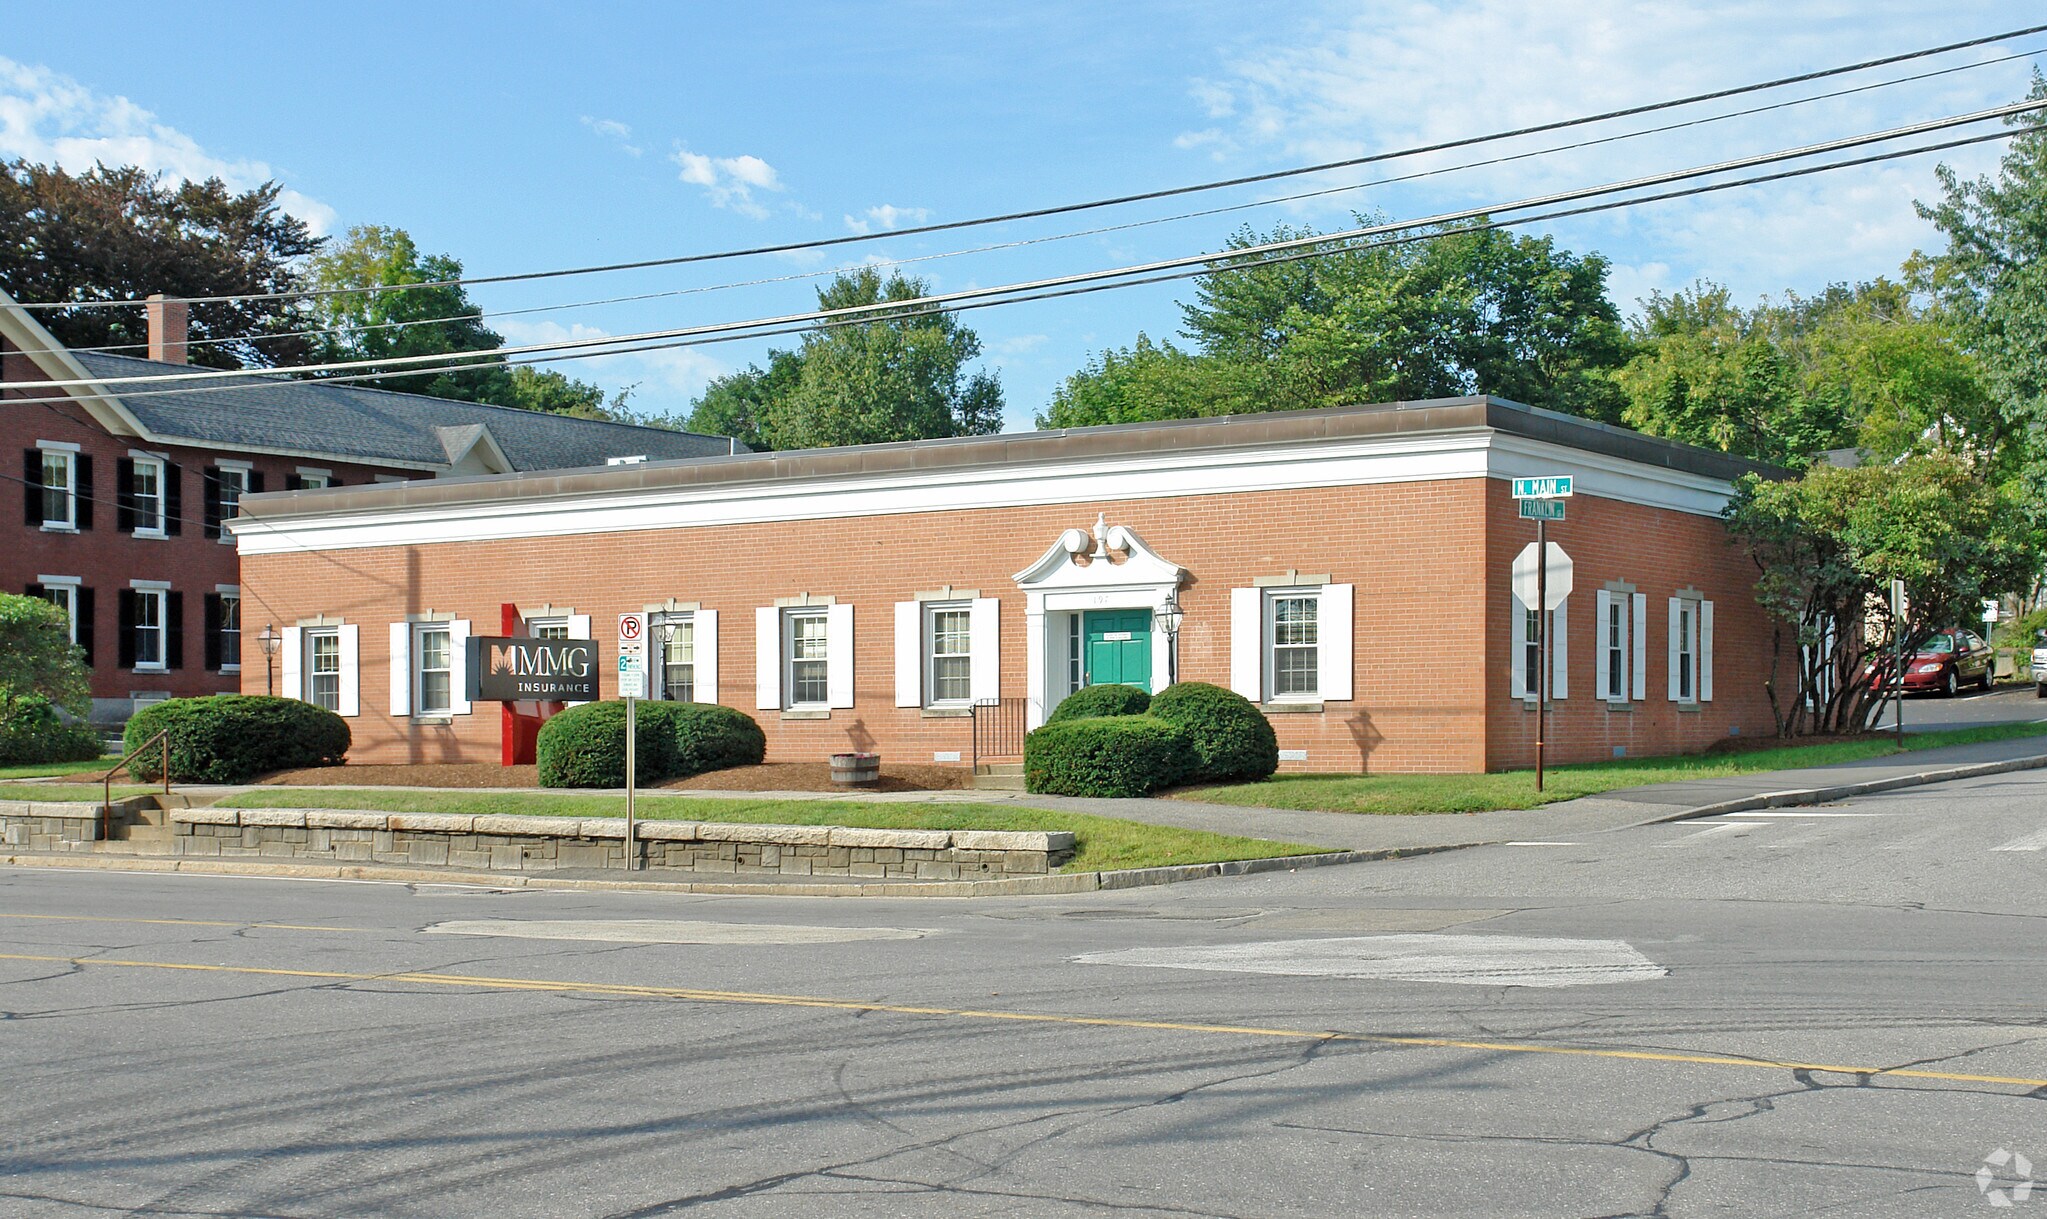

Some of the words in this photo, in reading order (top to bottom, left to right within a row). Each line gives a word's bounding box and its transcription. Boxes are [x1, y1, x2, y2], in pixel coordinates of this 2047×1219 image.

[1532, 480, 1556, 494] MAIN
[1524, 501, 1554, 516] FRANKLIN
[621, 659, 627, 669] 2
[518, 682, 590, 692] INSURANCE
